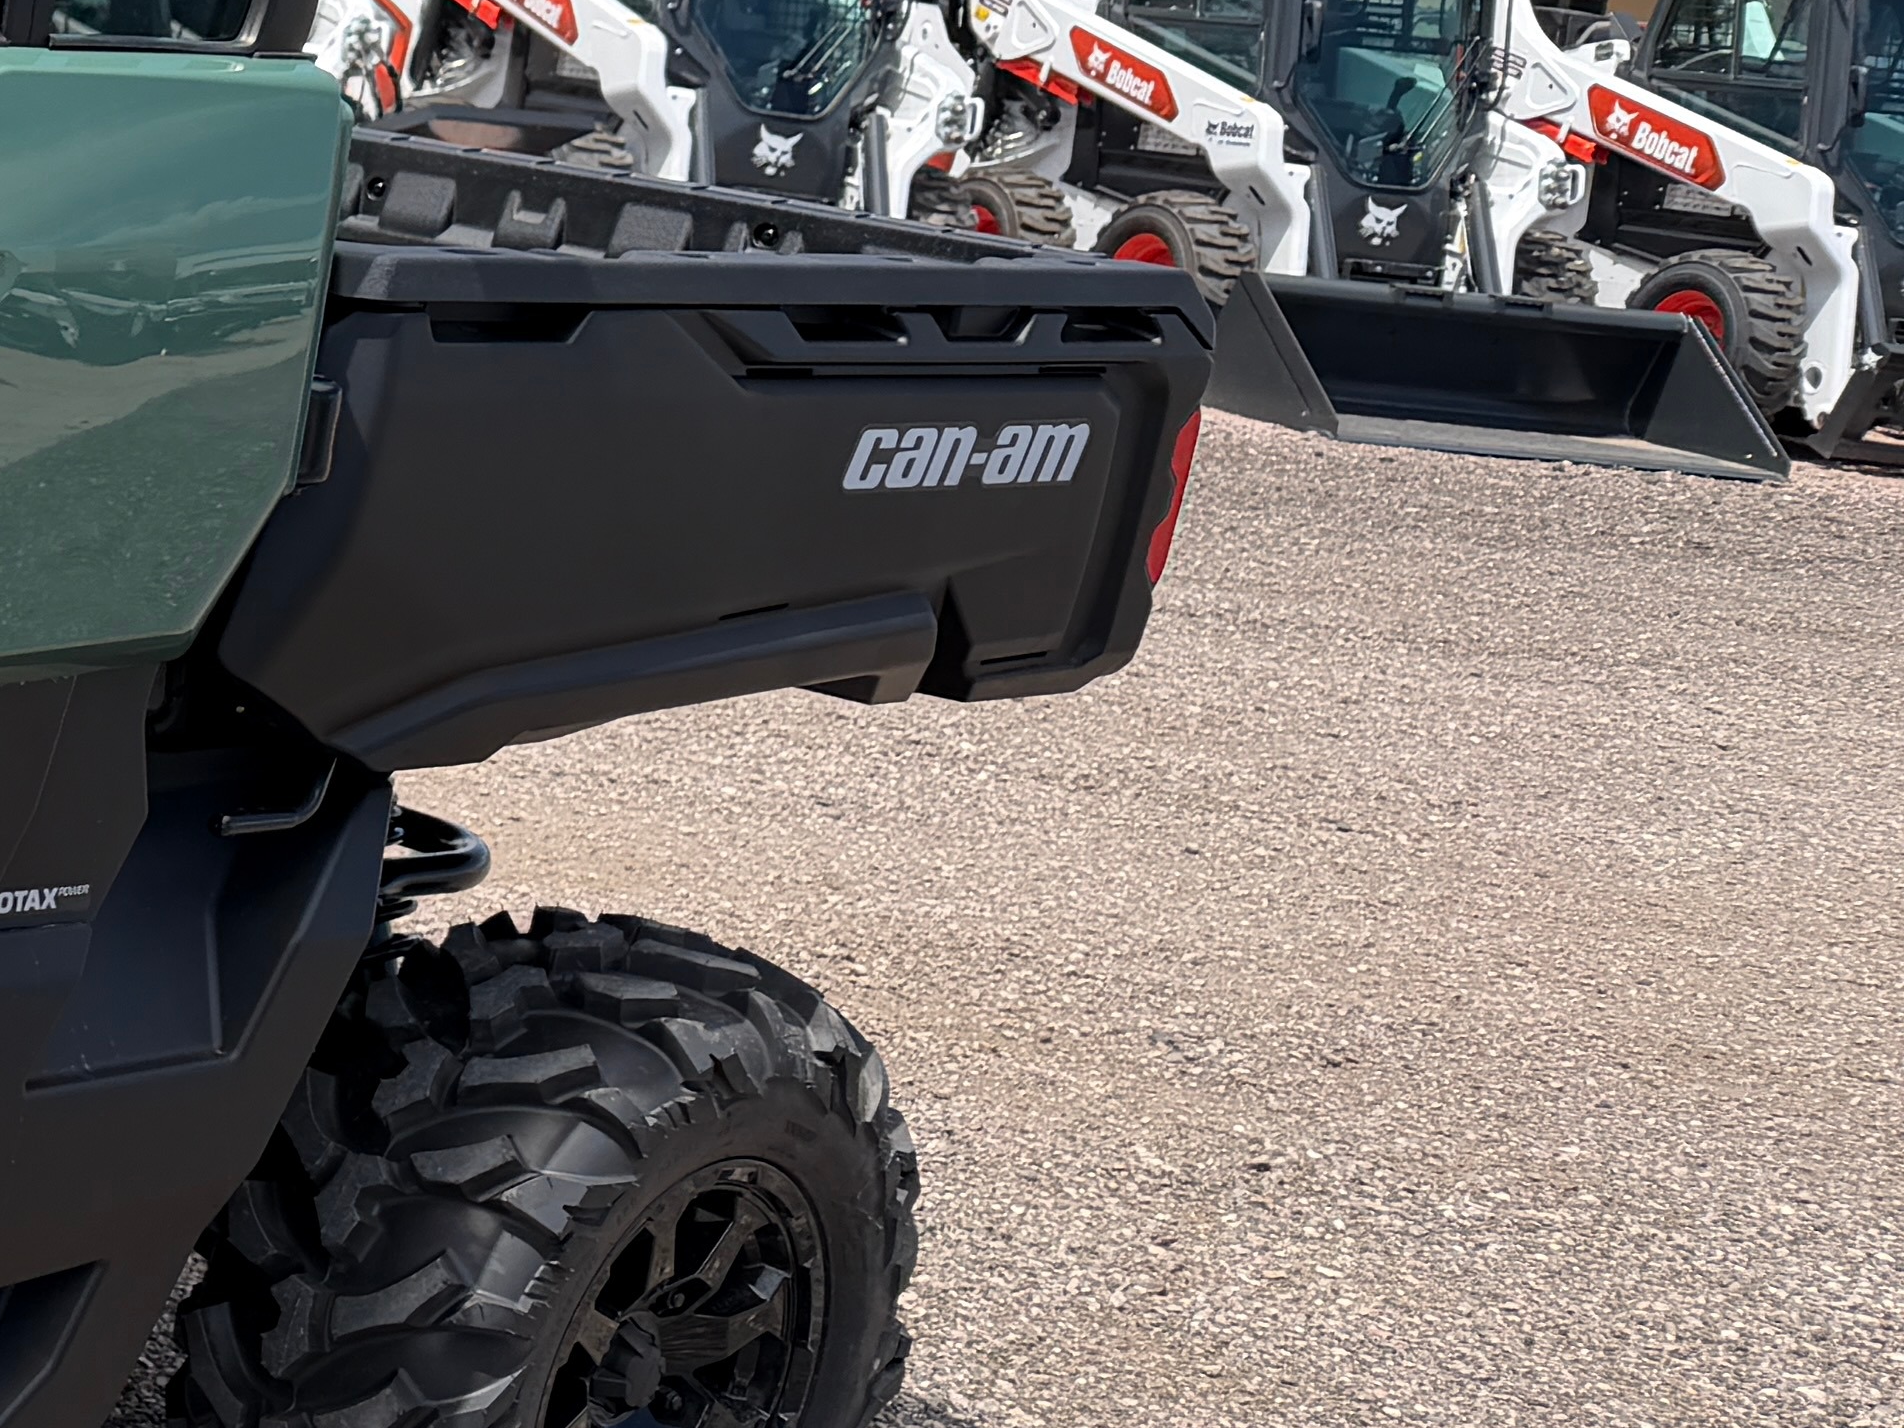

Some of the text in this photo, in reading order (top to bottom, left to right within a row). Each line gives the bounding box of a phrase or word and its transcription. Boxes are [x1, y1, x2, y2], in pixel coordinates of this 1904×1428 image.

[1106, 60, 1157, 105] Bobcat
[1219, 120, 1255, 140] Bobcat
[1630, 121, 1700, 174] Bobcat
[842, 422, 1091, 491] can-am
